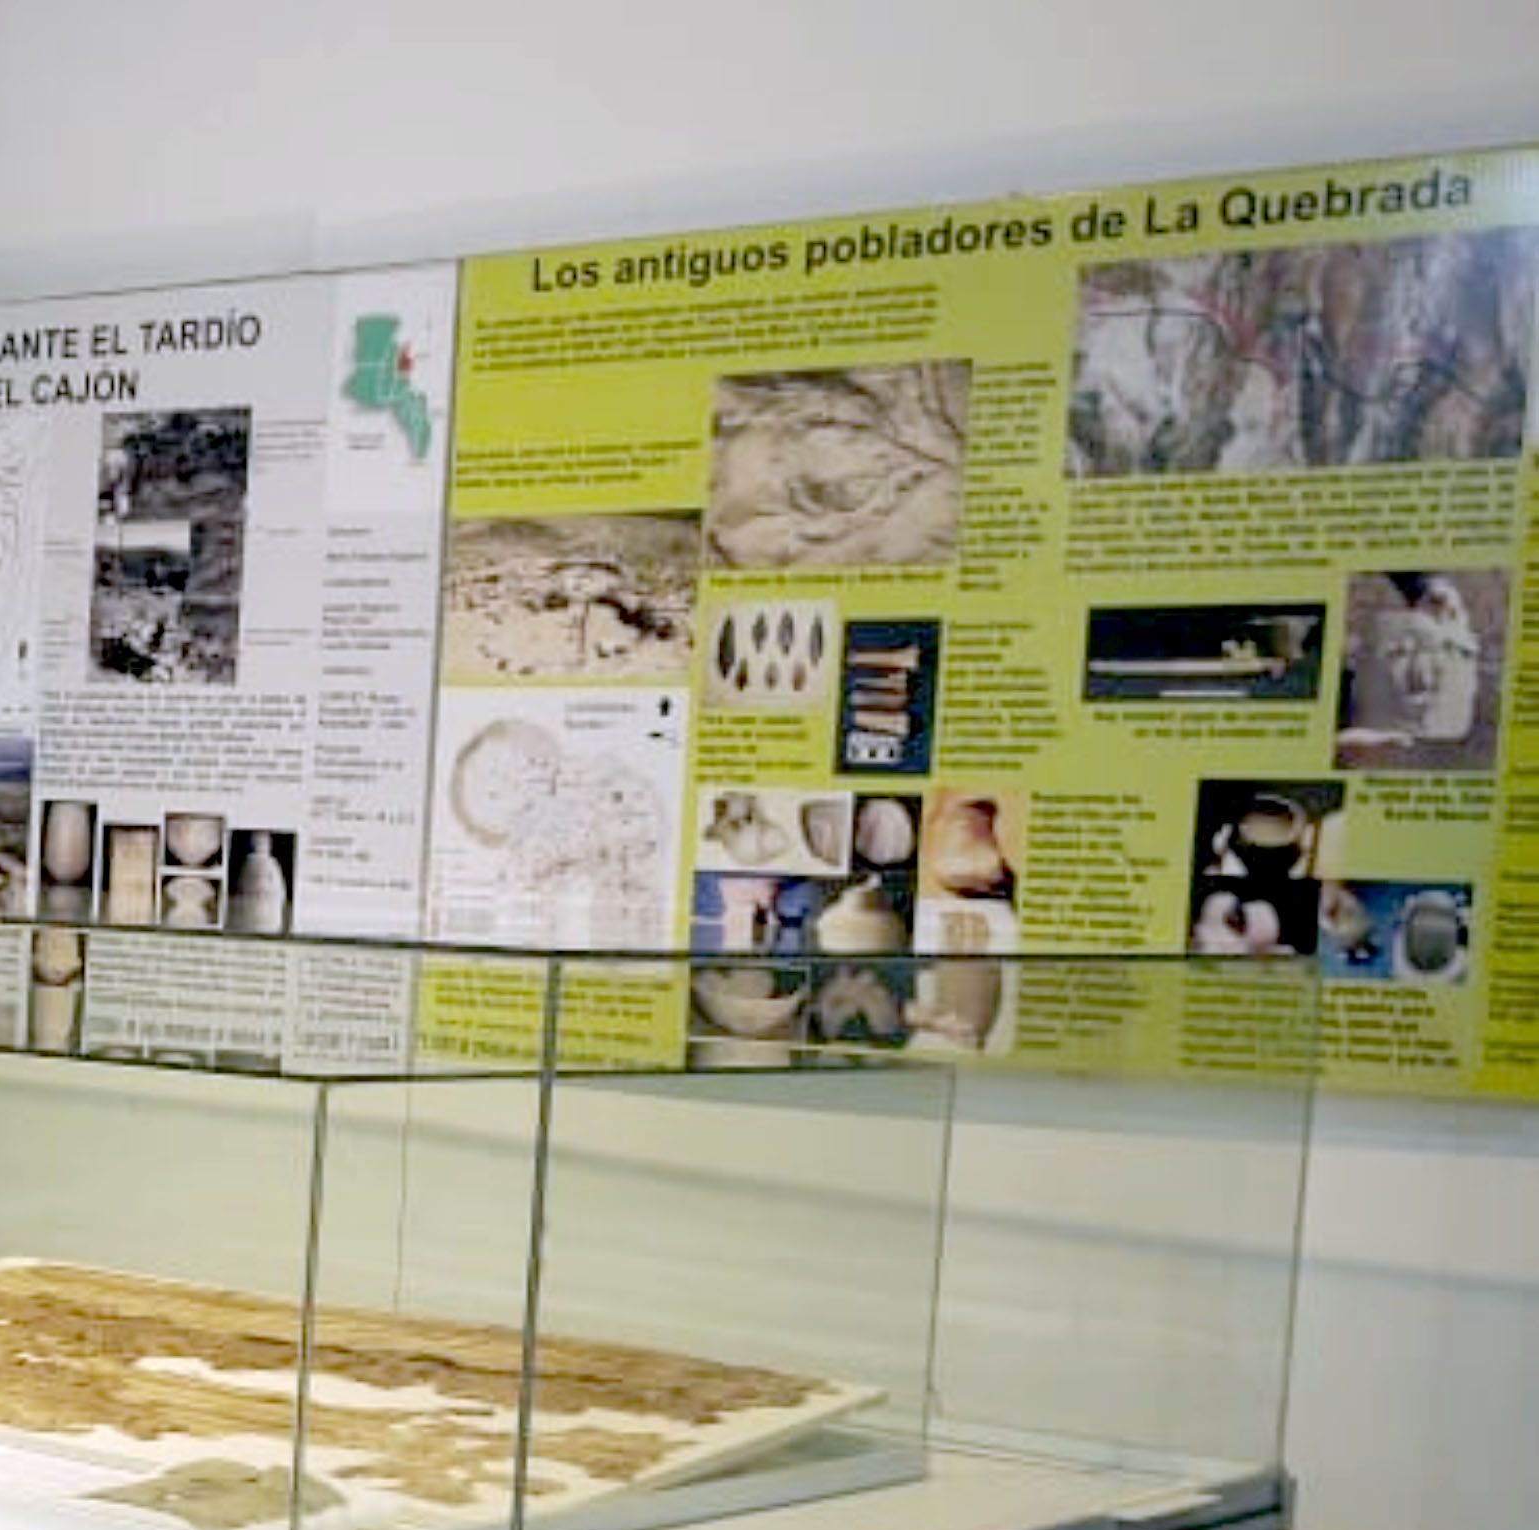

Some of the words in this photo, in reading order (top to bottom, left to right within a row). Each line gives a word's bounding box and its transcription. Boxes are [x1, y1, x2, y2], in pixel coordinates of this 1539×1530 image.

[533, 257, 600, 291] Los
[614, 241, 789, 287] antiguos
[804, 215, 1052, 277] pobladores
[1071, 203, 1127, 241] de
[1144, 194, 1200, 235] La
[1218, 168, 1470, 229] Quebrada
[91, 324, 128, 357] EL
[139, 311, 261, 351] TARDÍO
[30, 362, 140, 405] CAJÓN
